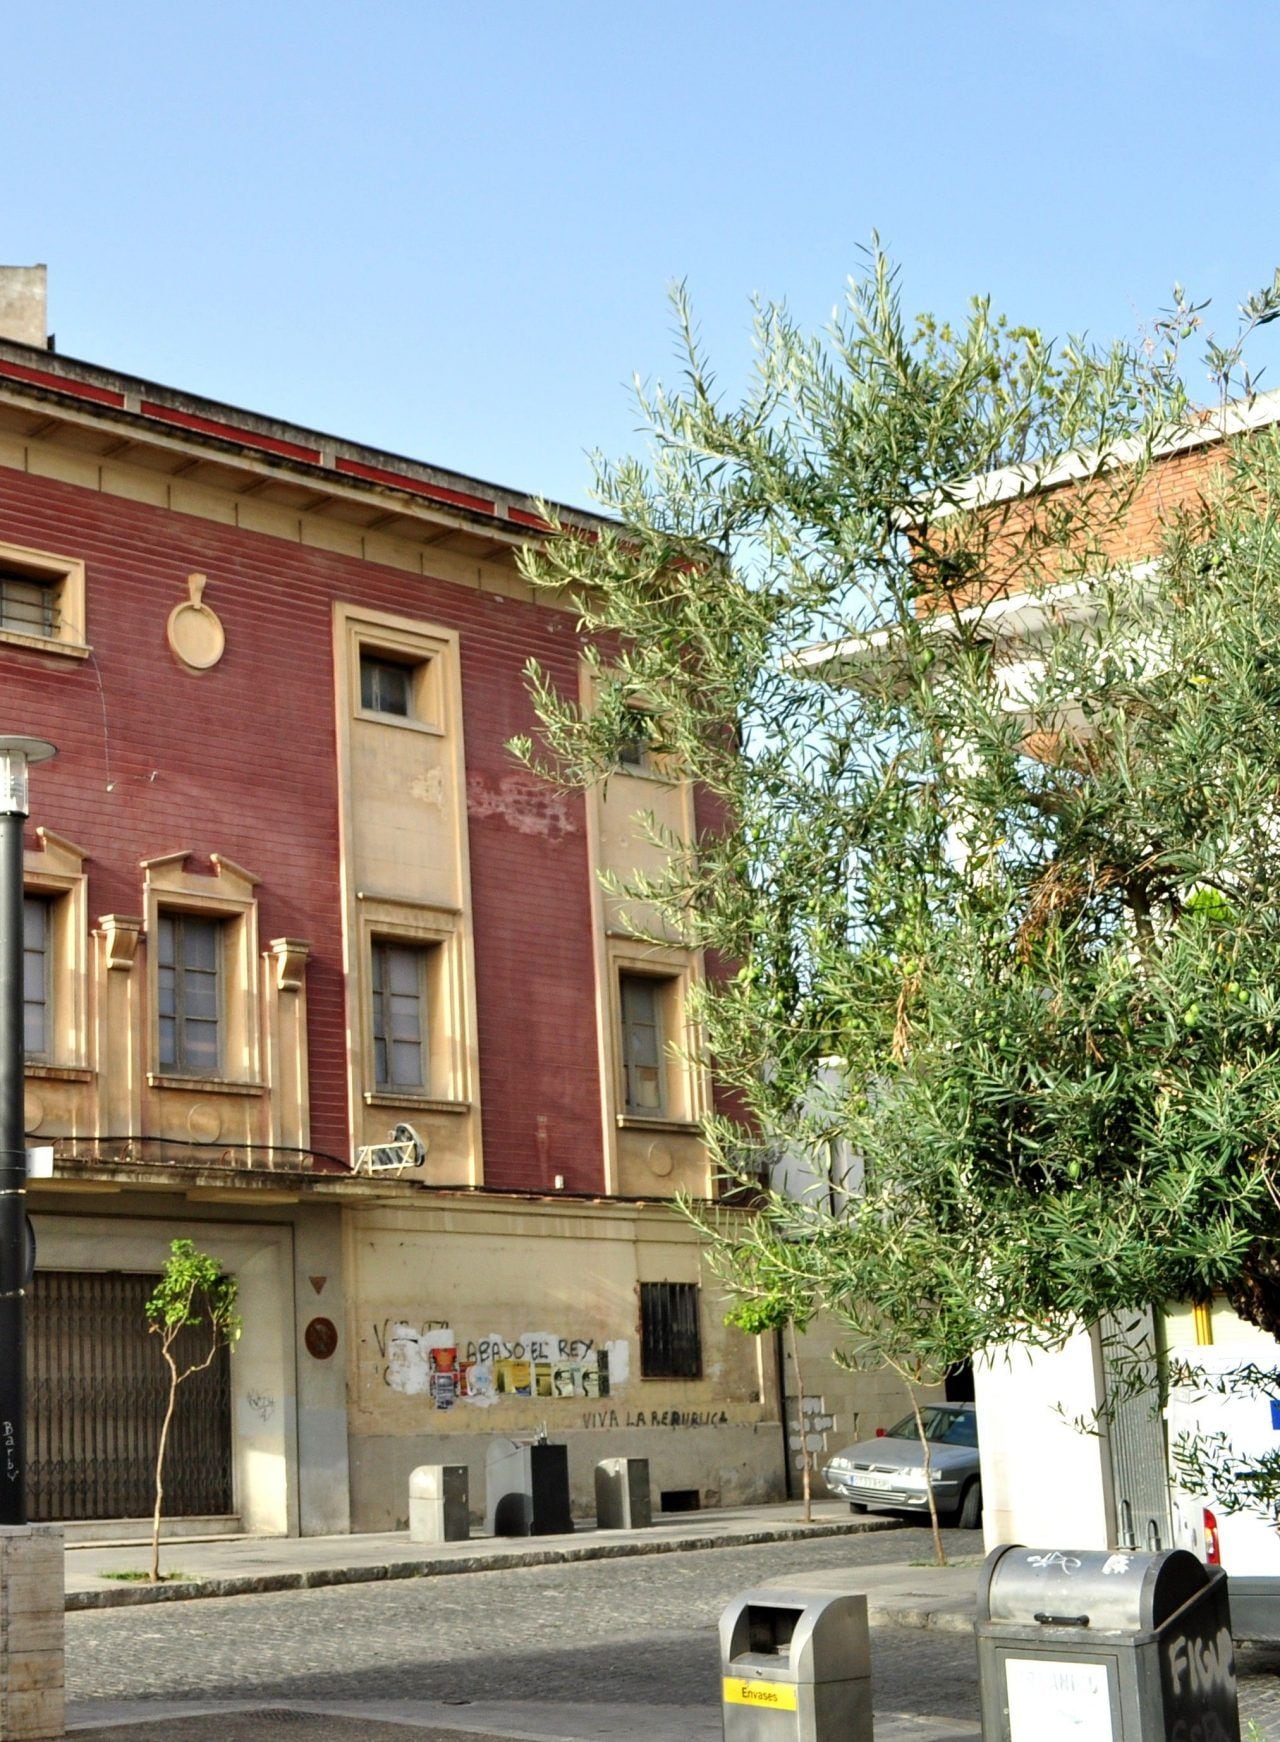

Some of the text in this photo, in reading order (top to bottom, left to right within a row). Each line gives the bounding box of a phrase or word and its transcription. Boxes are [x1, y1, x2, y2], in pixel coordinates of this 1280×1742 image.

[531, 1341, 548, 1360] EL
[558, 1339, 594, 1360] REY
[583, 1409, 619, 1429] VIVA
[626, 1411, 646, 1427] LA
[741, 1687, 778, 1702] Envases
